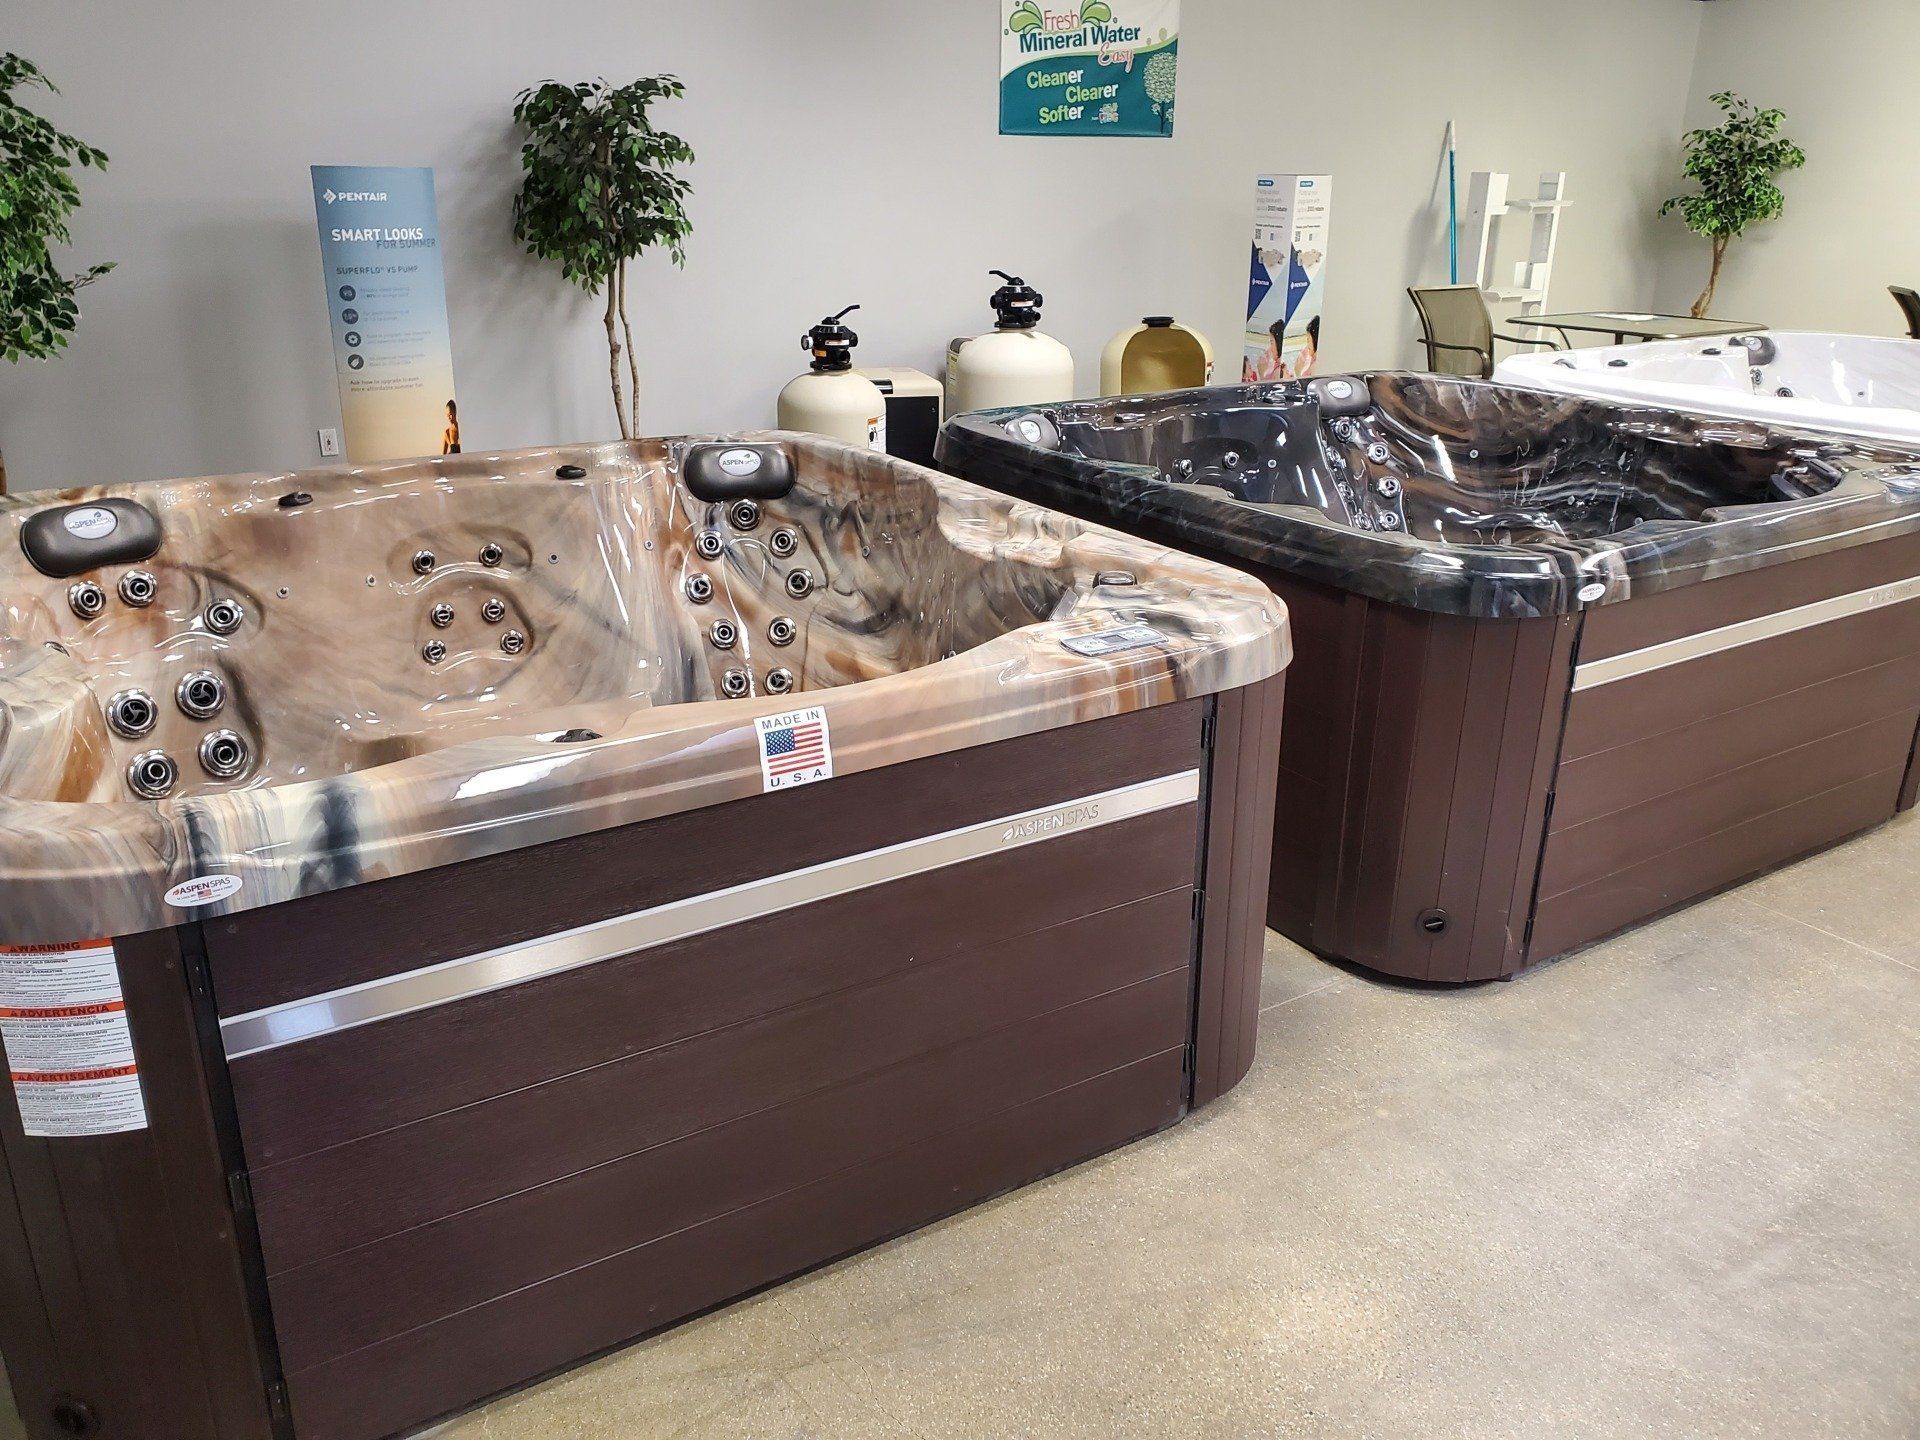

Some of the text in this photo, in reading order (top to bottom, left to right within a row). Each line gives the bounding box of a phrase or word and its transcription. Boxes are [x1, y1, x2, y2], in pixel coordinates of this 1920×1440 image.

[1044, 10, 1080, 31] Fresh
[1020, 26, 1141, 53] Mineral Water
[1098, 42, 1133, 73] Easy
[1026, 69, 1084, 89] Cleaner
[1065, 83, 1119, 104] Clearer
[1039, 104, 1084, 124] Softer
[338, 192, 388, 201] PENTAIR
[332, 228, 424, 242] SMART LOOKS
[376, 238, 436, 250] FOR SUMMER
[387, 266, 397, 274] VS
[398, 265, 418, 273] PUMP
[762, 710, 820, 729] MADE IN
[17, 941, 80, 952] WARNING
[20, 1006, 109, 1017] ADVERTENCIA
[26, 1068, 129, 1080] AVERTISSEMENT
